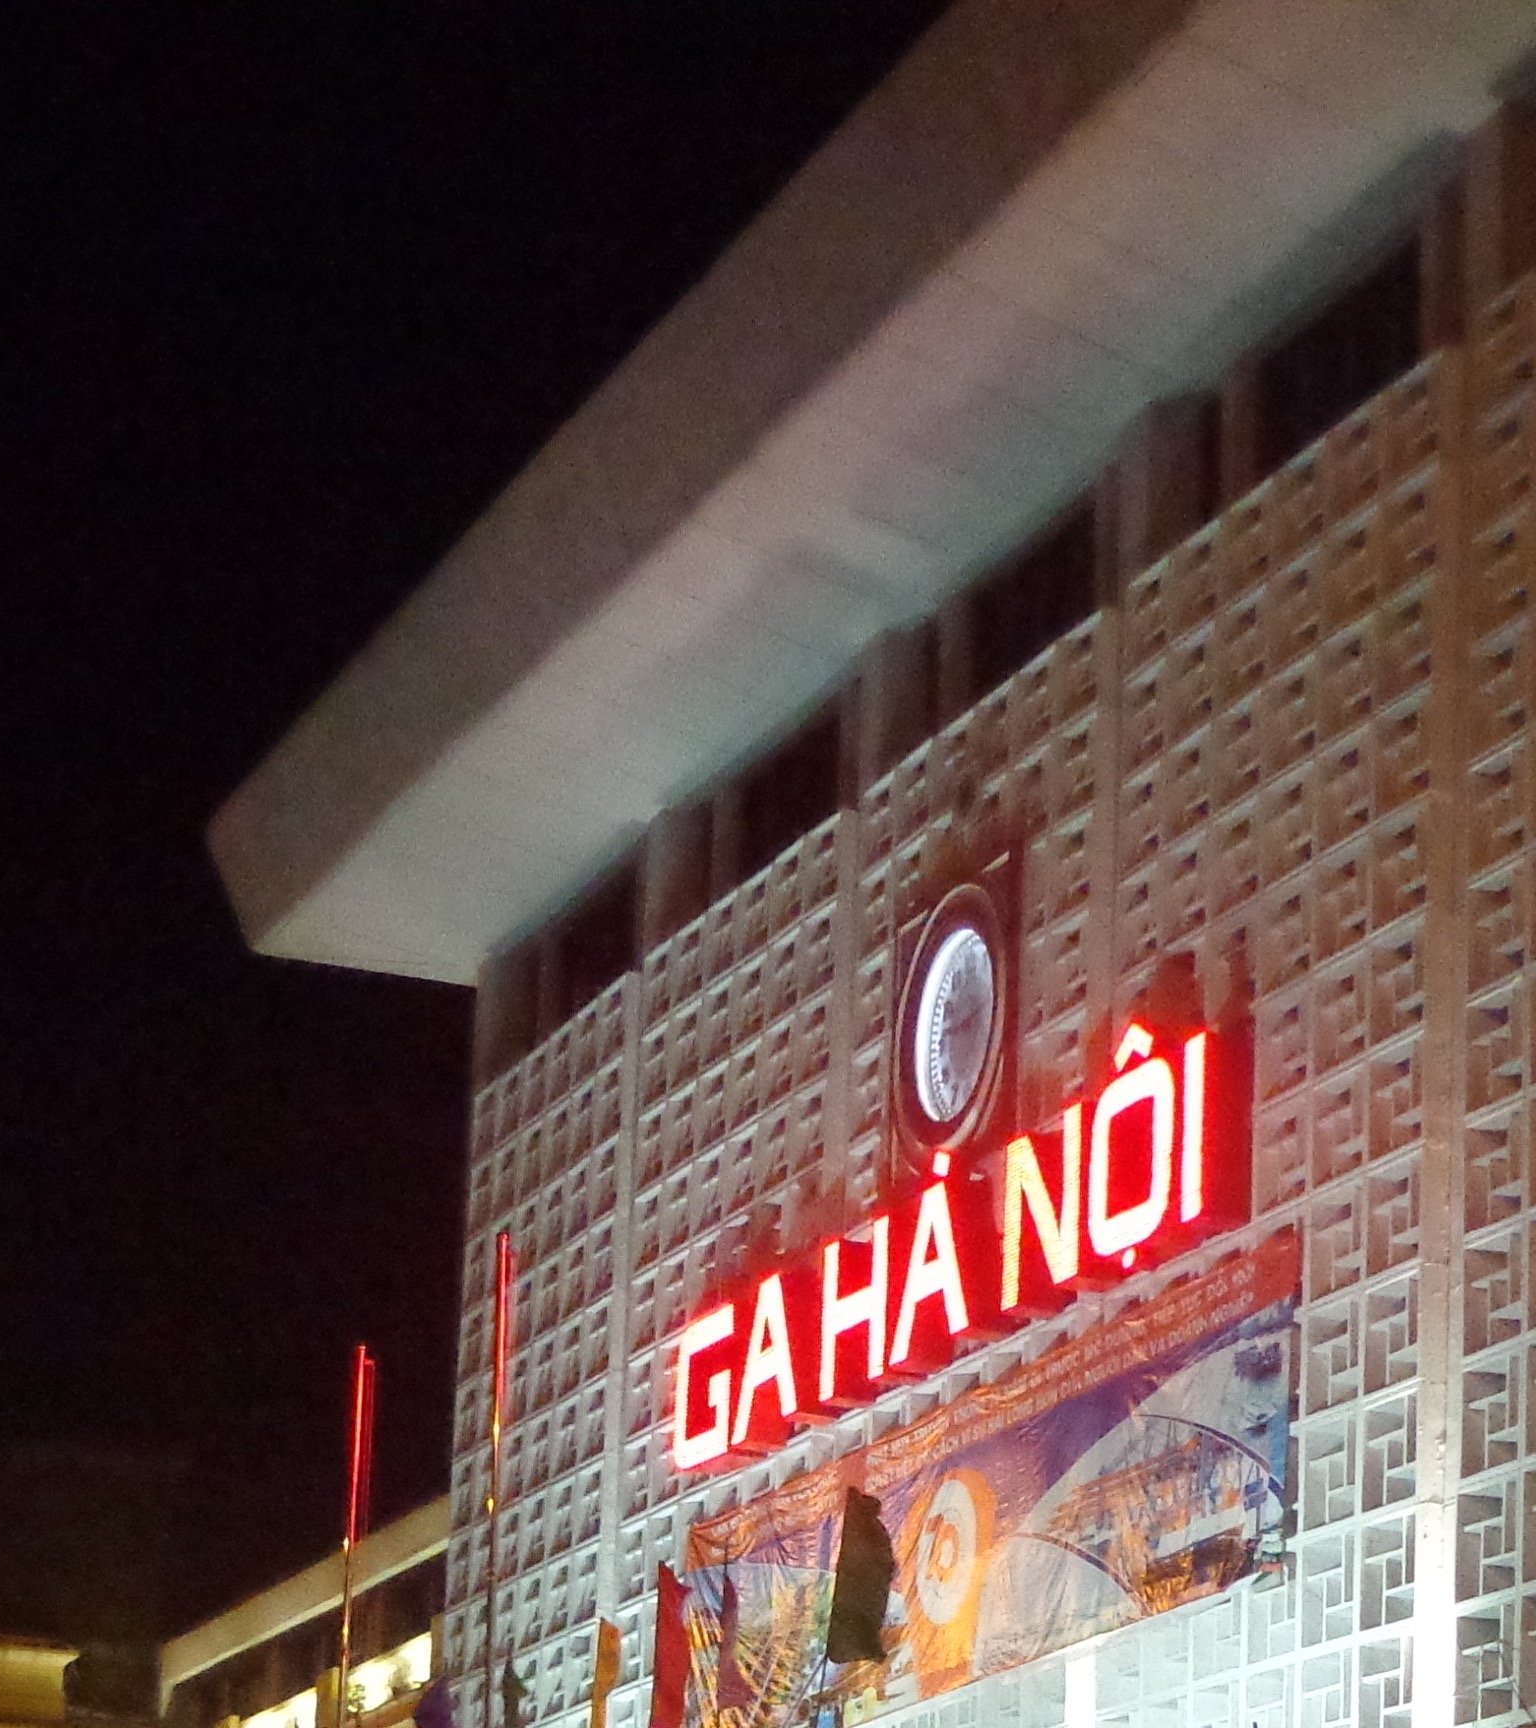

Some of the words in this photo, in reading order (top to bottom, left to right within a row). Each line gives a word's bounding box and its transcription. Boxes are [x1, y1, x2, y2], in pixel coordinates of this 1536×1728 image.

[673, 1275, 797, 1470] GA
[820, 1151, 969, 1401] HÀ
[1001, 1023, 1206, 1312] NỘI
